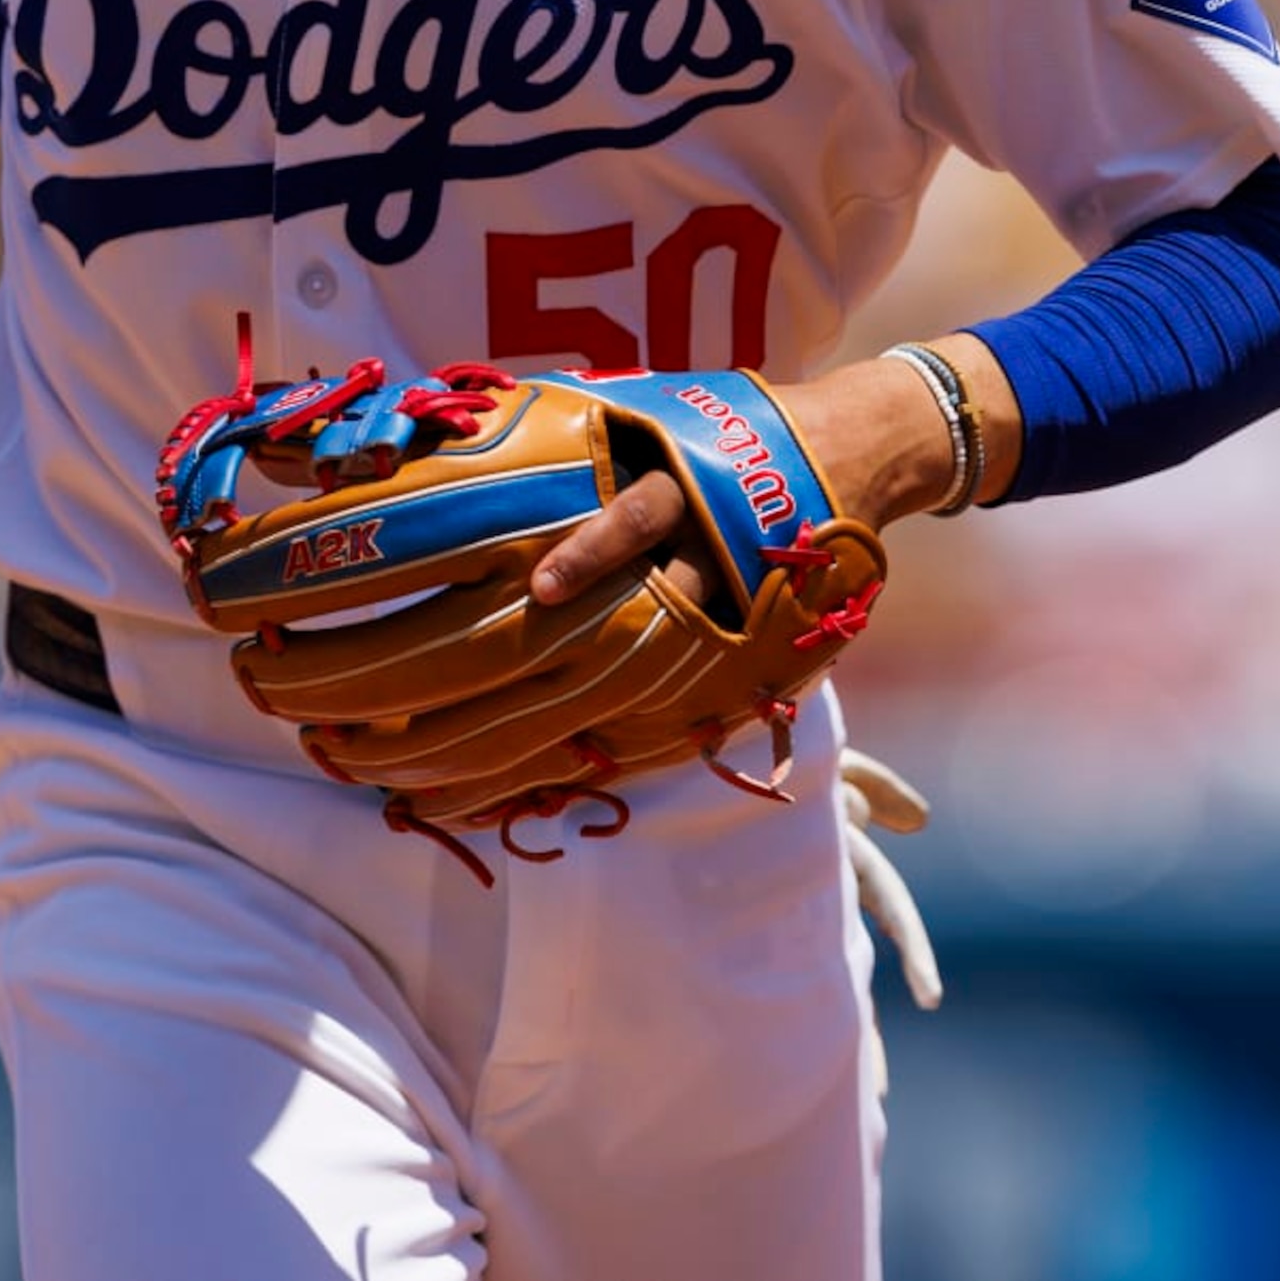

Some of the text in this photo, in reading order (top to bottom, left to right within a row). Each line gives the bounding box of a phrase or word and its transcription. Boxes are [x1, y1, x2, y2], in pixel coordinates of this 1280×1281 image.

[486, 203, 782, 373] 50
[676, 384, 797, 535] Wilson
[283, 518, 385, 584] A2K
